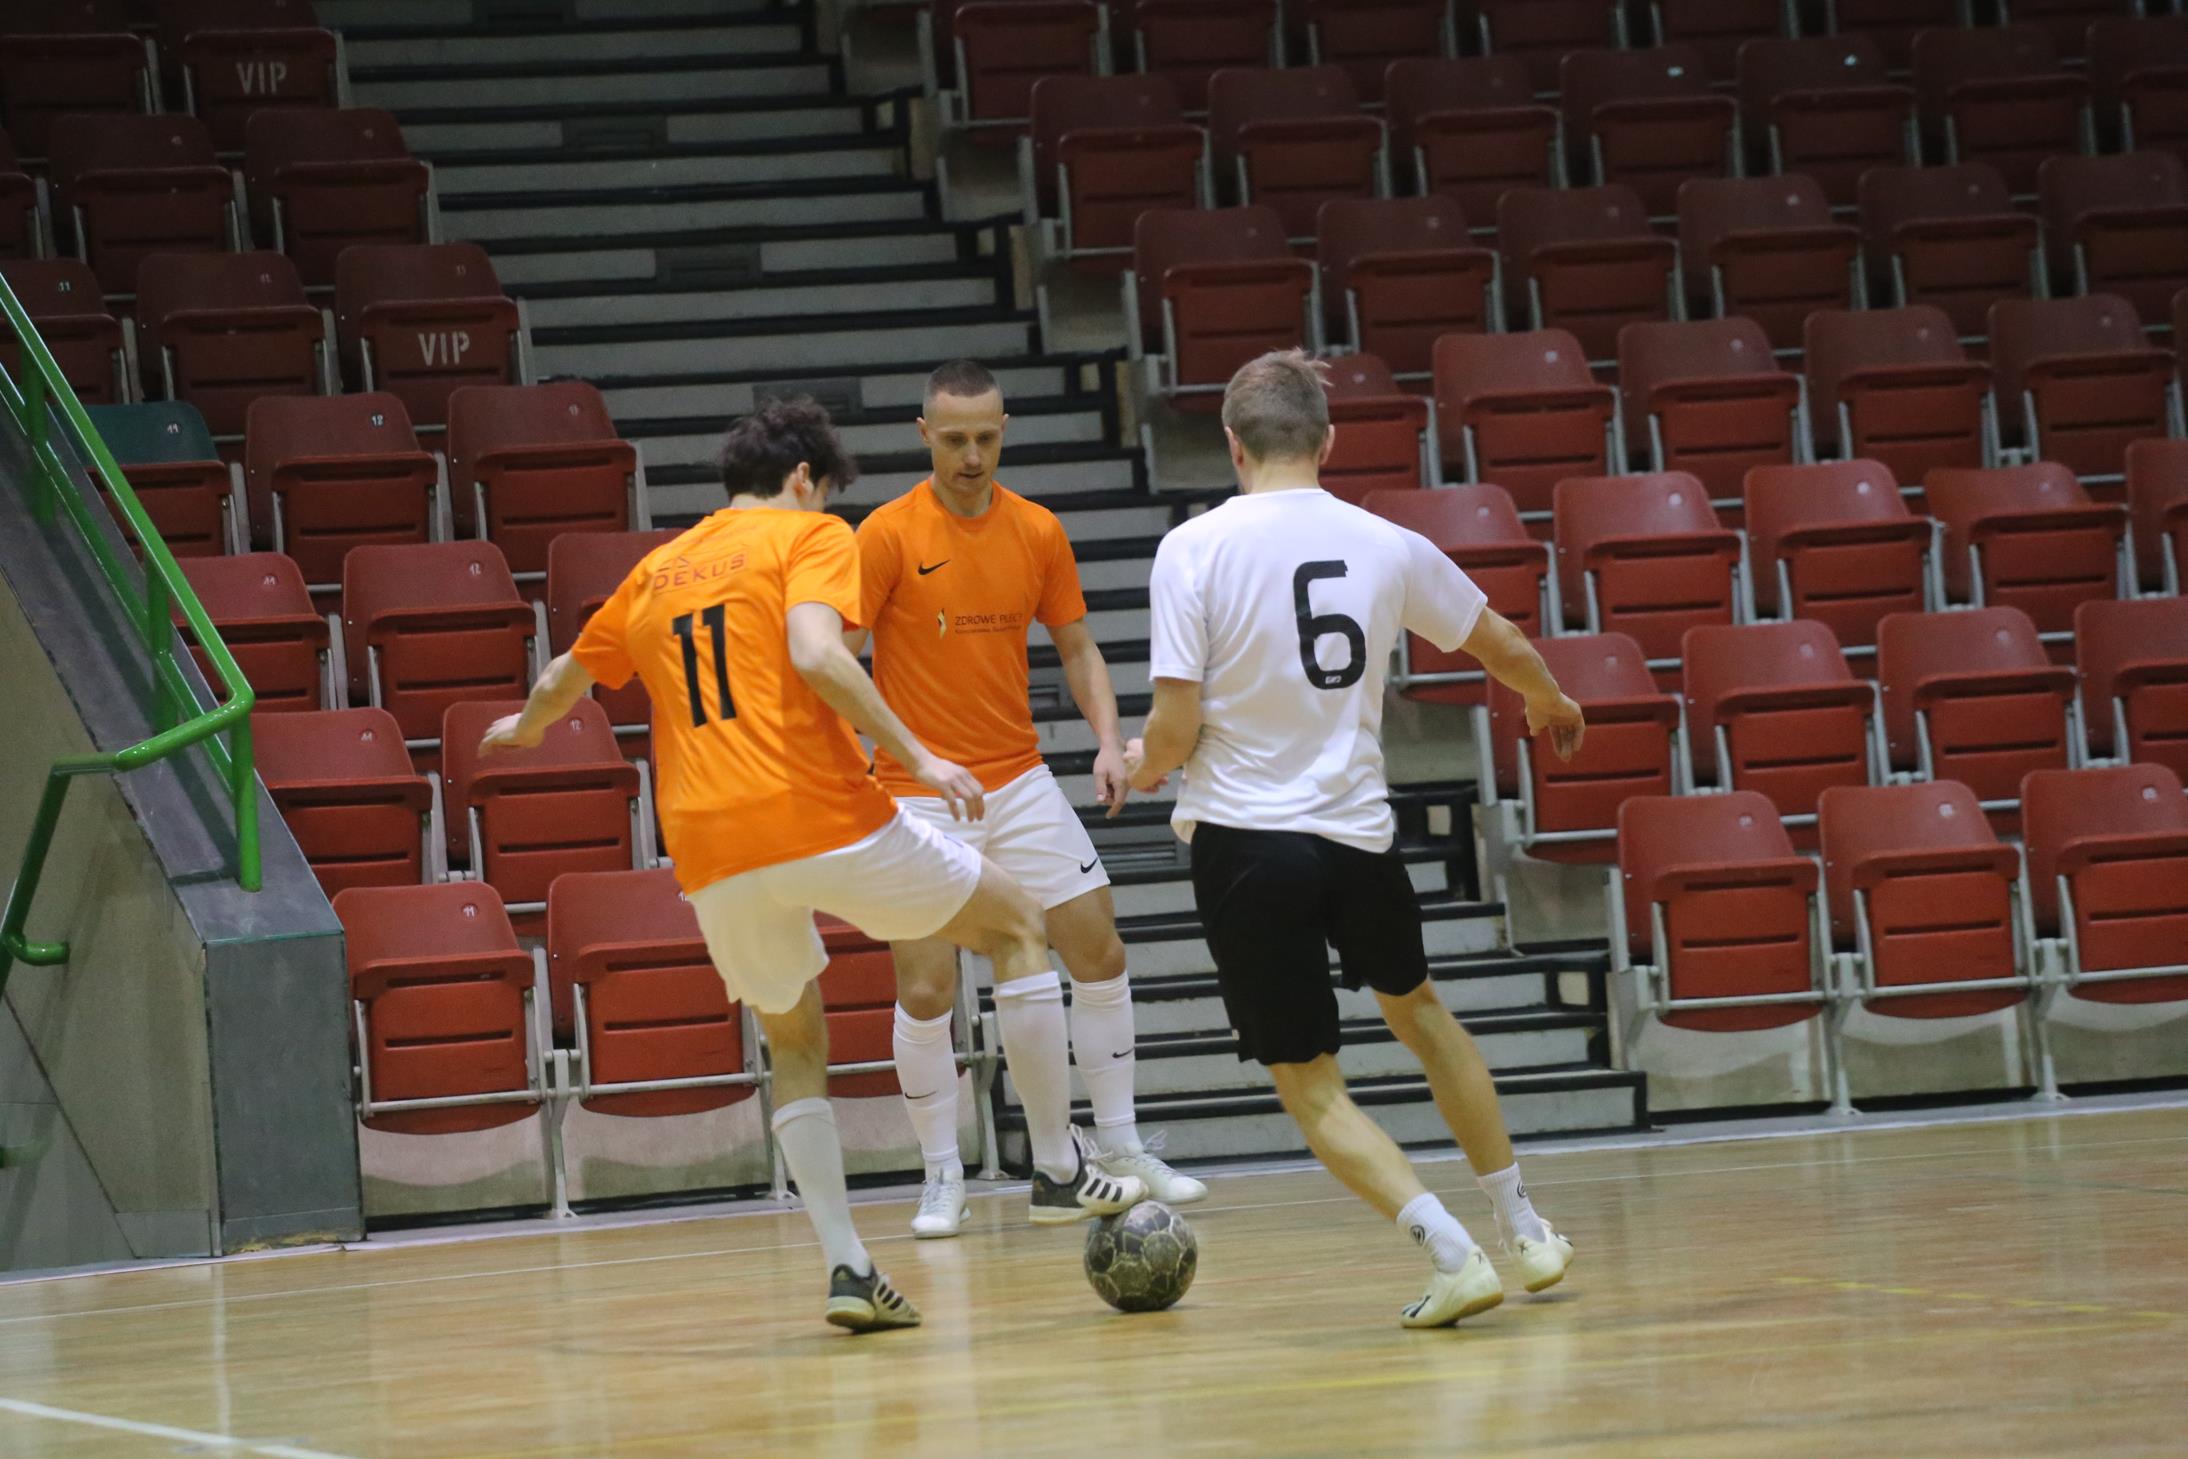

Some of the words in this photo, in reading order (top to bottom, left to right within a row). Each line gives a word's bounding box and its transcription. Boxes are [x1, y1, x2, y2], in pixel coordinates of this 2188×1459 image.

[236, 61, 287, 95] VIP
[418, 331, 470, 366] VIP
[655, 553, 745, 590] DEKUS
[955, 614, 996, 626] ZDROWE
[1293, 559, 1366, 690] 6
[672, 603, 737, 728] 11
